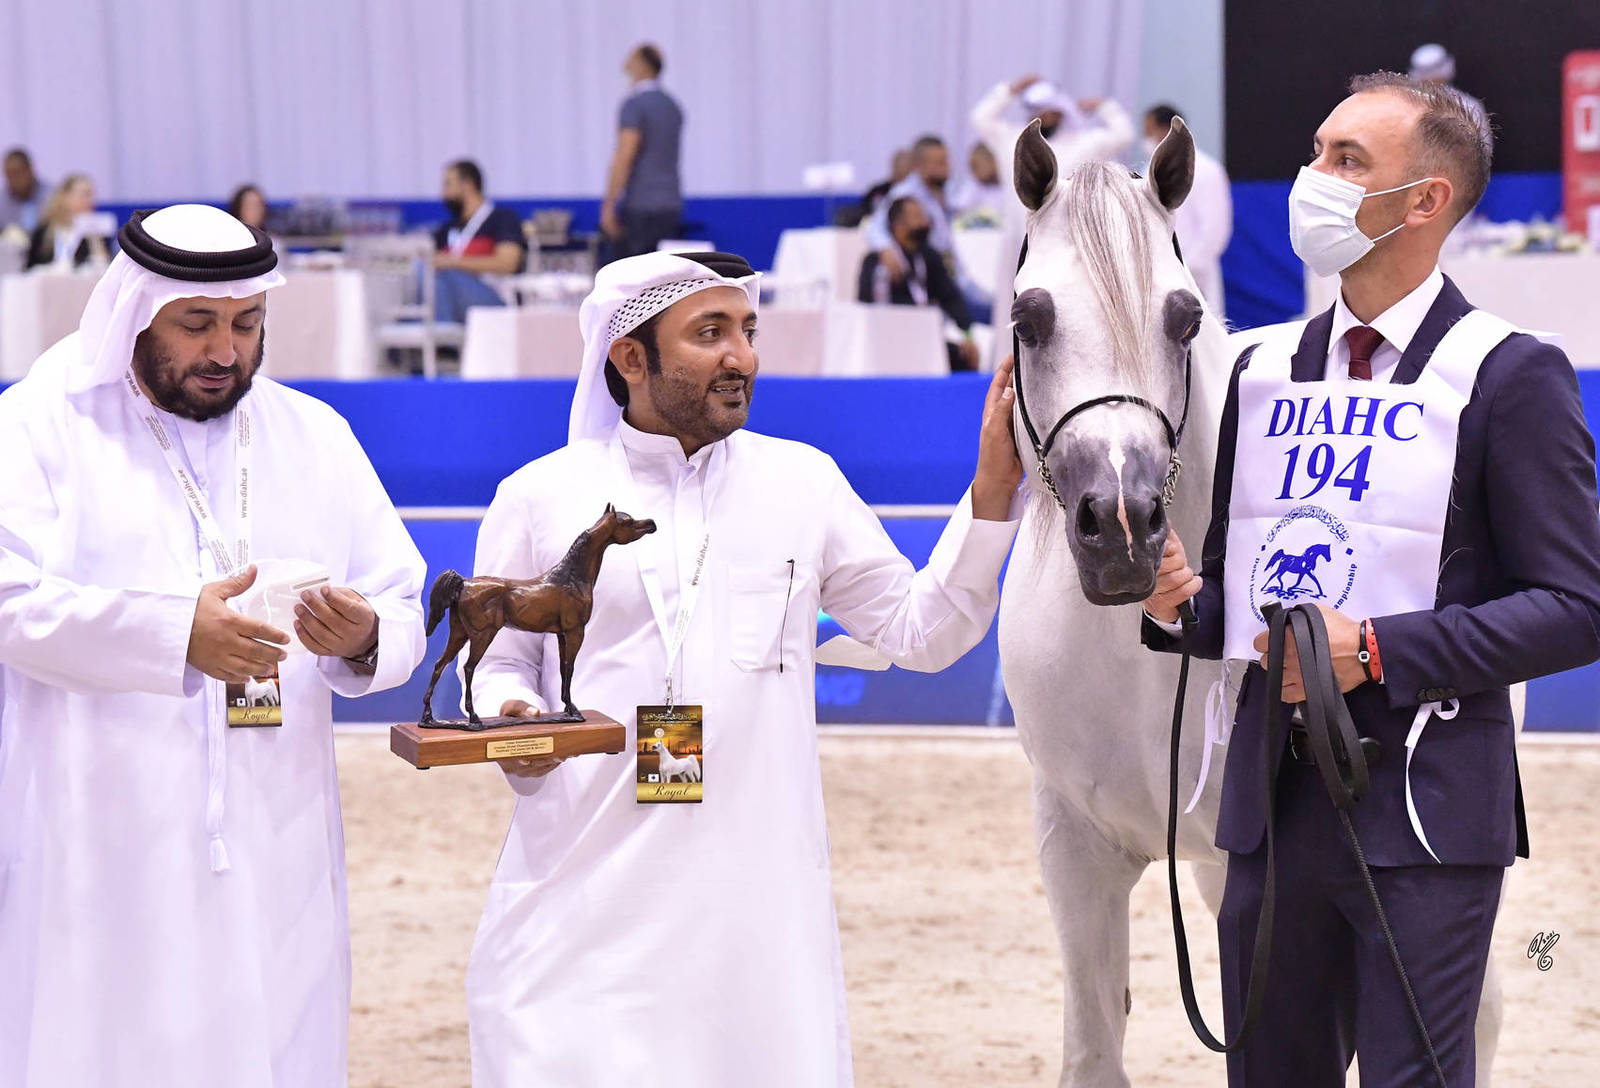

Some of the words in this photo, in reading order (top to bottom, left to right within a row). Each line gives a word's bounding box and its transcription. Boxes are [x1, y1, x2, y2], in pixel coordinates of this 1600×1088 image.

[1264, 396, 1424, 441] DIAHC
[178, 469, 207, 519] www.diahc.ae
[240, 467, 248, 519] www.diahc.ae
[1275, 443, 1373, 502] 194
[1333, 563, 1358, 610] ampionship
[240, 708, 273, 724] Royal
[654, 783, 691, 800] Royal
